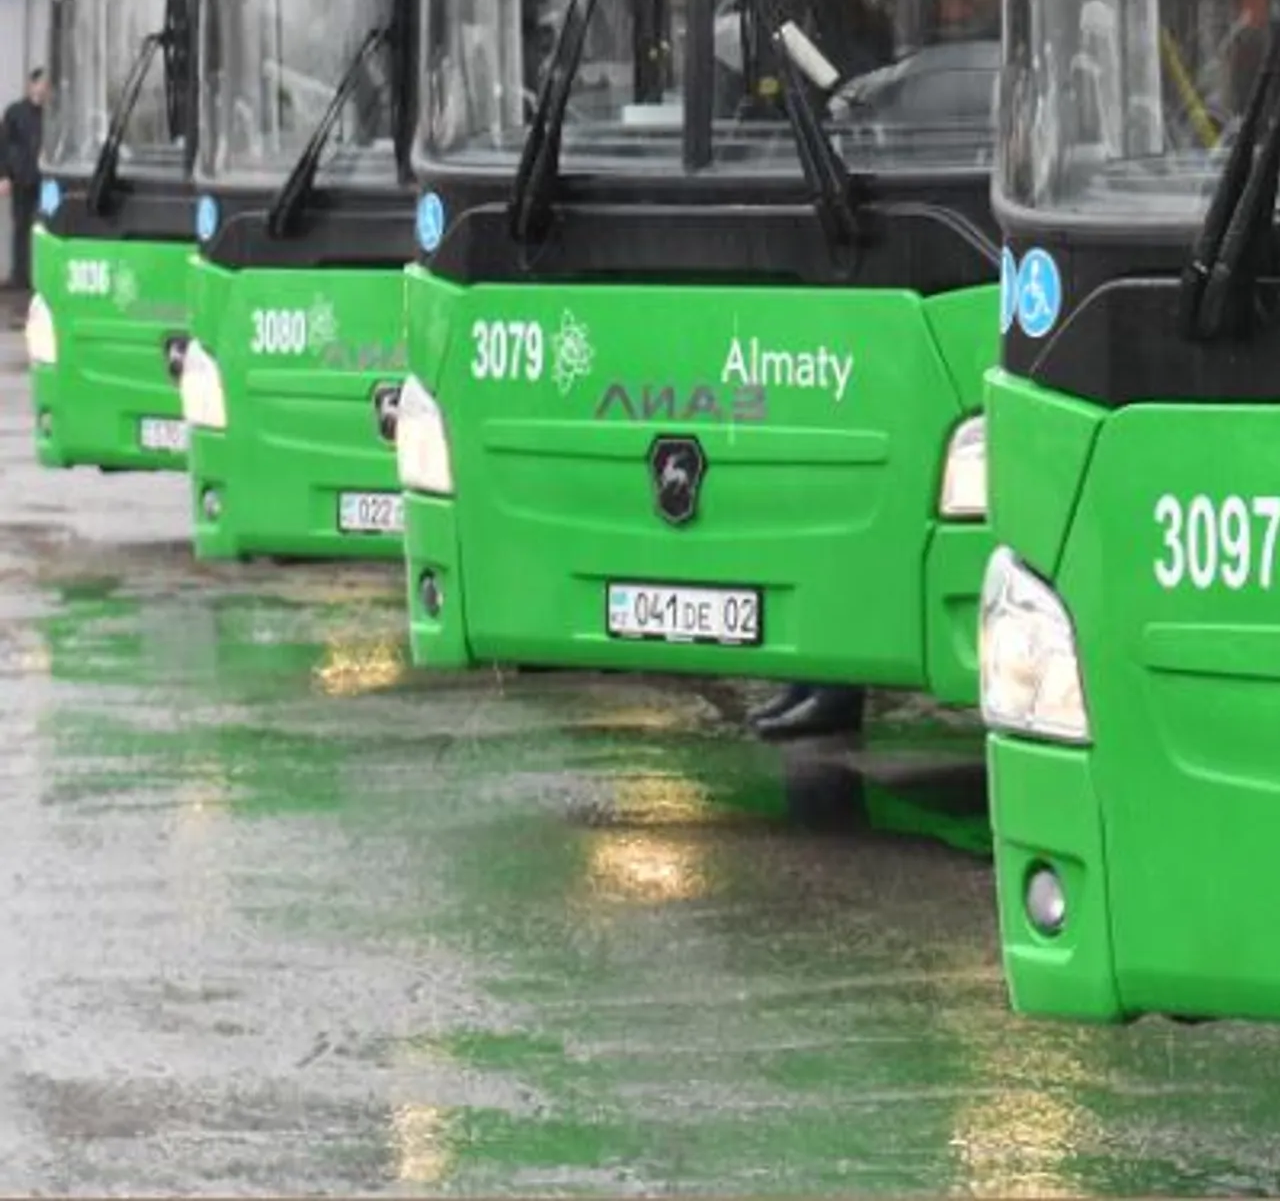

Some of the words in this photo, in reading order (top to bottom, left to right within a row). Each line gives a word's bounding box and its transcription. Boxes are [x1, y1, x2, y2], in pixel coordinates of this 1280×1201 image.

[471, 319, 543, 382] 3079
[720, 336, 853, 401] Almaty
[634, 592, 679, 629] 041
[723, 597, 757, 633] 02
